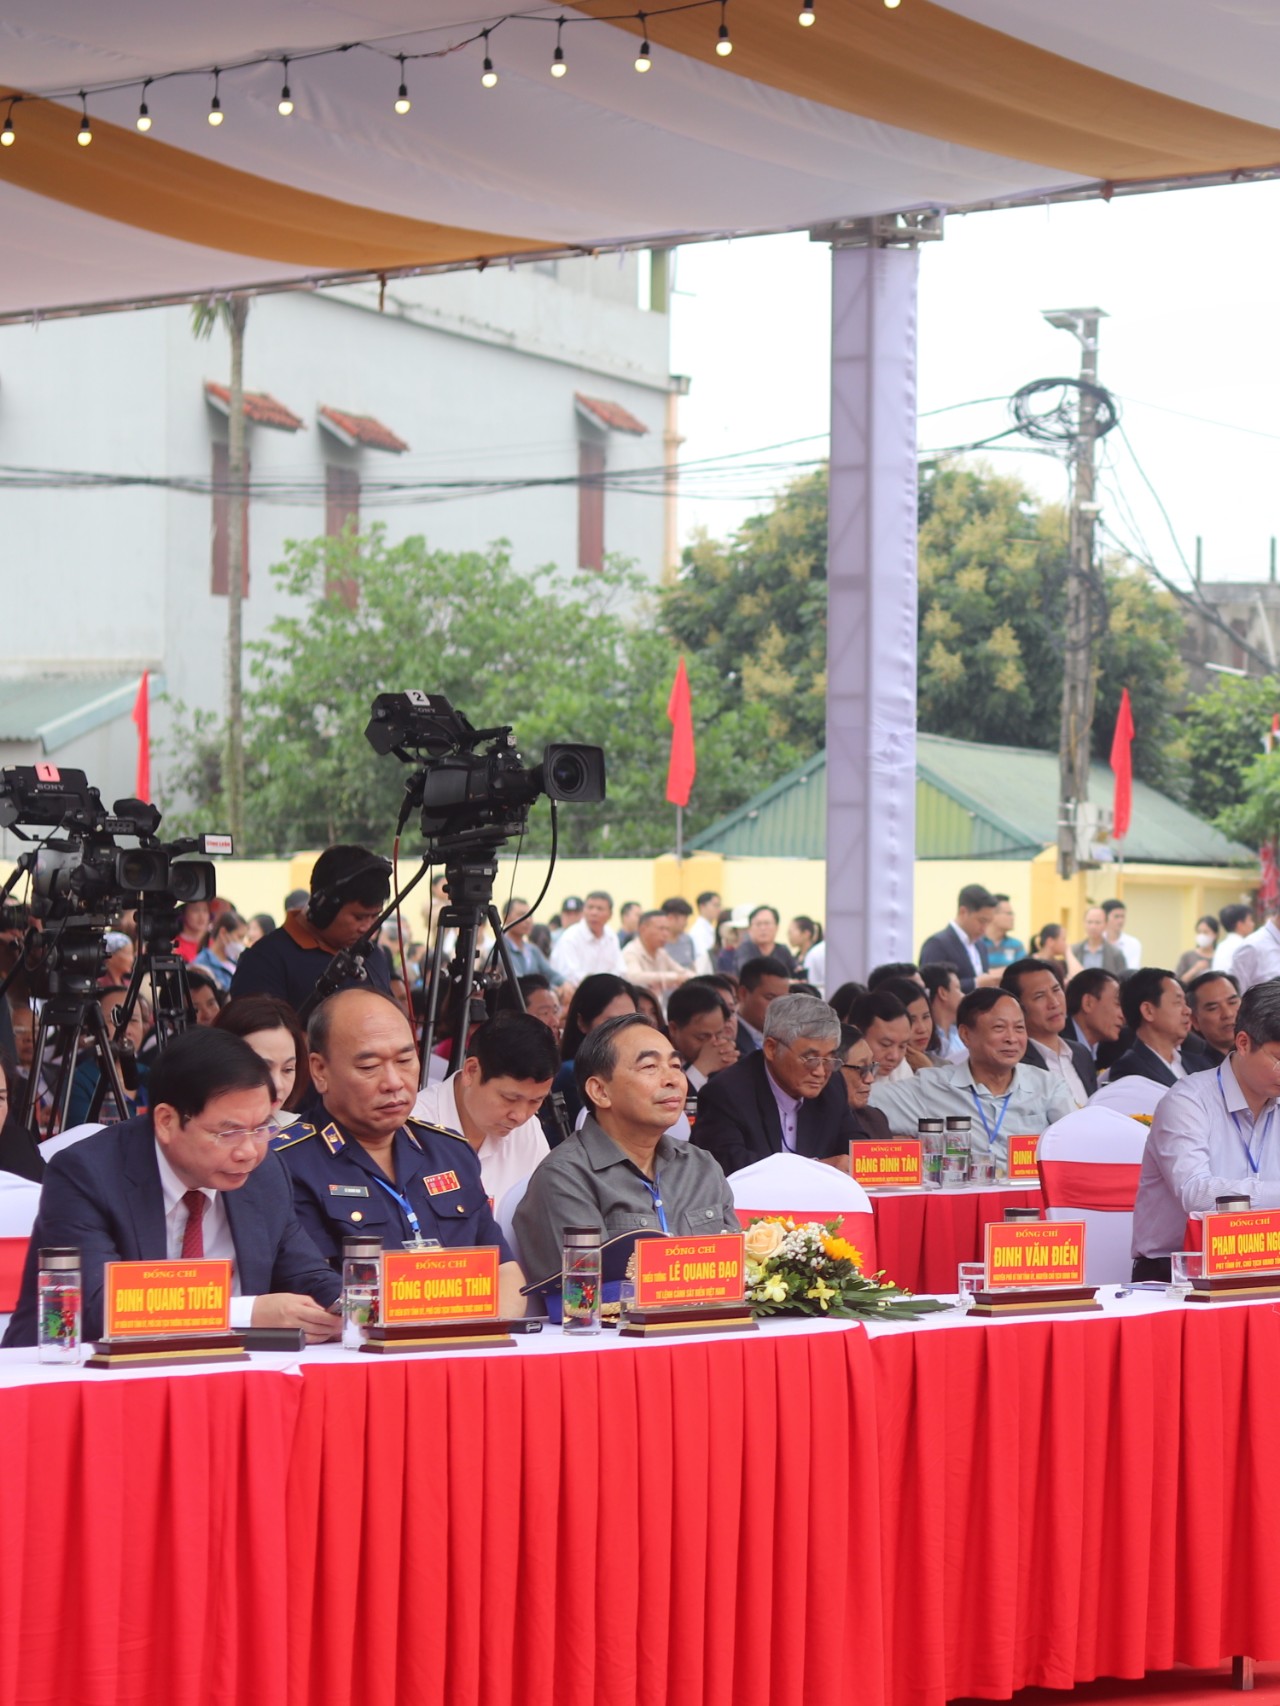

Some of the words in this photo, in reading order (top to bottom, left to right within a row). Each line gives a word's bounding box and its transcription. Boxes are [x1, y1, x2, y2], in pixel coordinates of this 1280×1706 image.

[413, 692, 424, 701] 2
[44, 765, 51, 777] 1
[37, 783, 64, 791] SONY
[994, 1247, 1022, 1267] ĐINH
[1025, 1242, 1049, 1267] VĂN
[1051, 1238, 1079, 1266] ĐIẾN
[1212, 1235, 1236, 1260] PHẠM
[1238, 1233, 1265, 1256] QUANG
[669, 1261, 680, 1281] LÊ
[683, 1262, 716, 1282] QUANG
[718, 1261, 738, 1282] ĐẠO
[391, 1274, 421, 1300] TỐNG
[424, 1278, 462, 1301] QUANG
[465, 1273, 491, 1296] THÌN
[116, 1289, 144, 1313] ĐINH
[147, 1287, 185, 1314] QUANG
